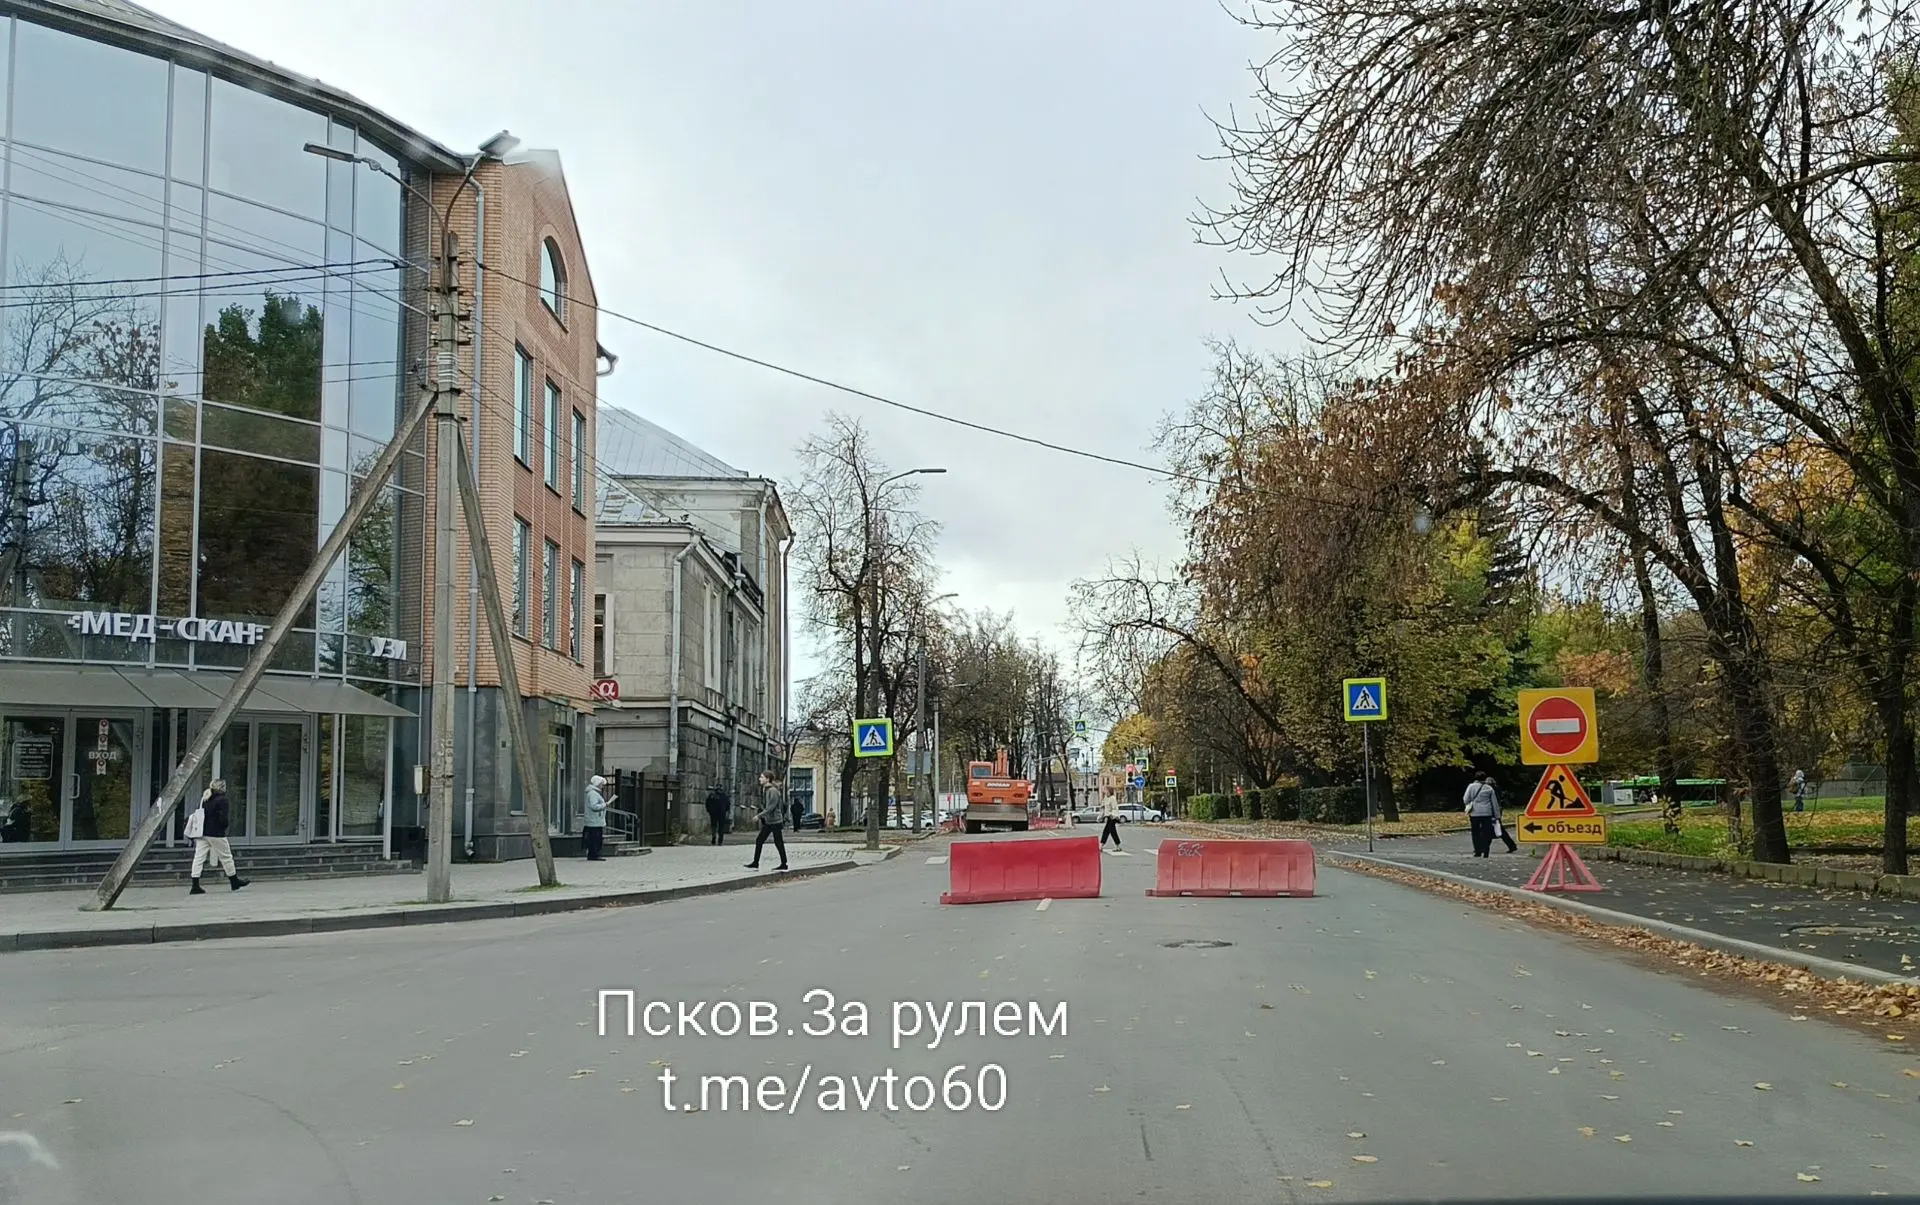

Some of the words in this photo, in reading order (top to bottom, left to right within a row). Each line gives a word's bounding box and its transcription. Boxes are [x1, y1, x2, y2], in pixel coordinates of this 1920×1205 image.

[370, 636, 407, 660] УЗИ
[88, 751, 117, 761] ВХОД
[1547, 821, 1602, 835] объезд
